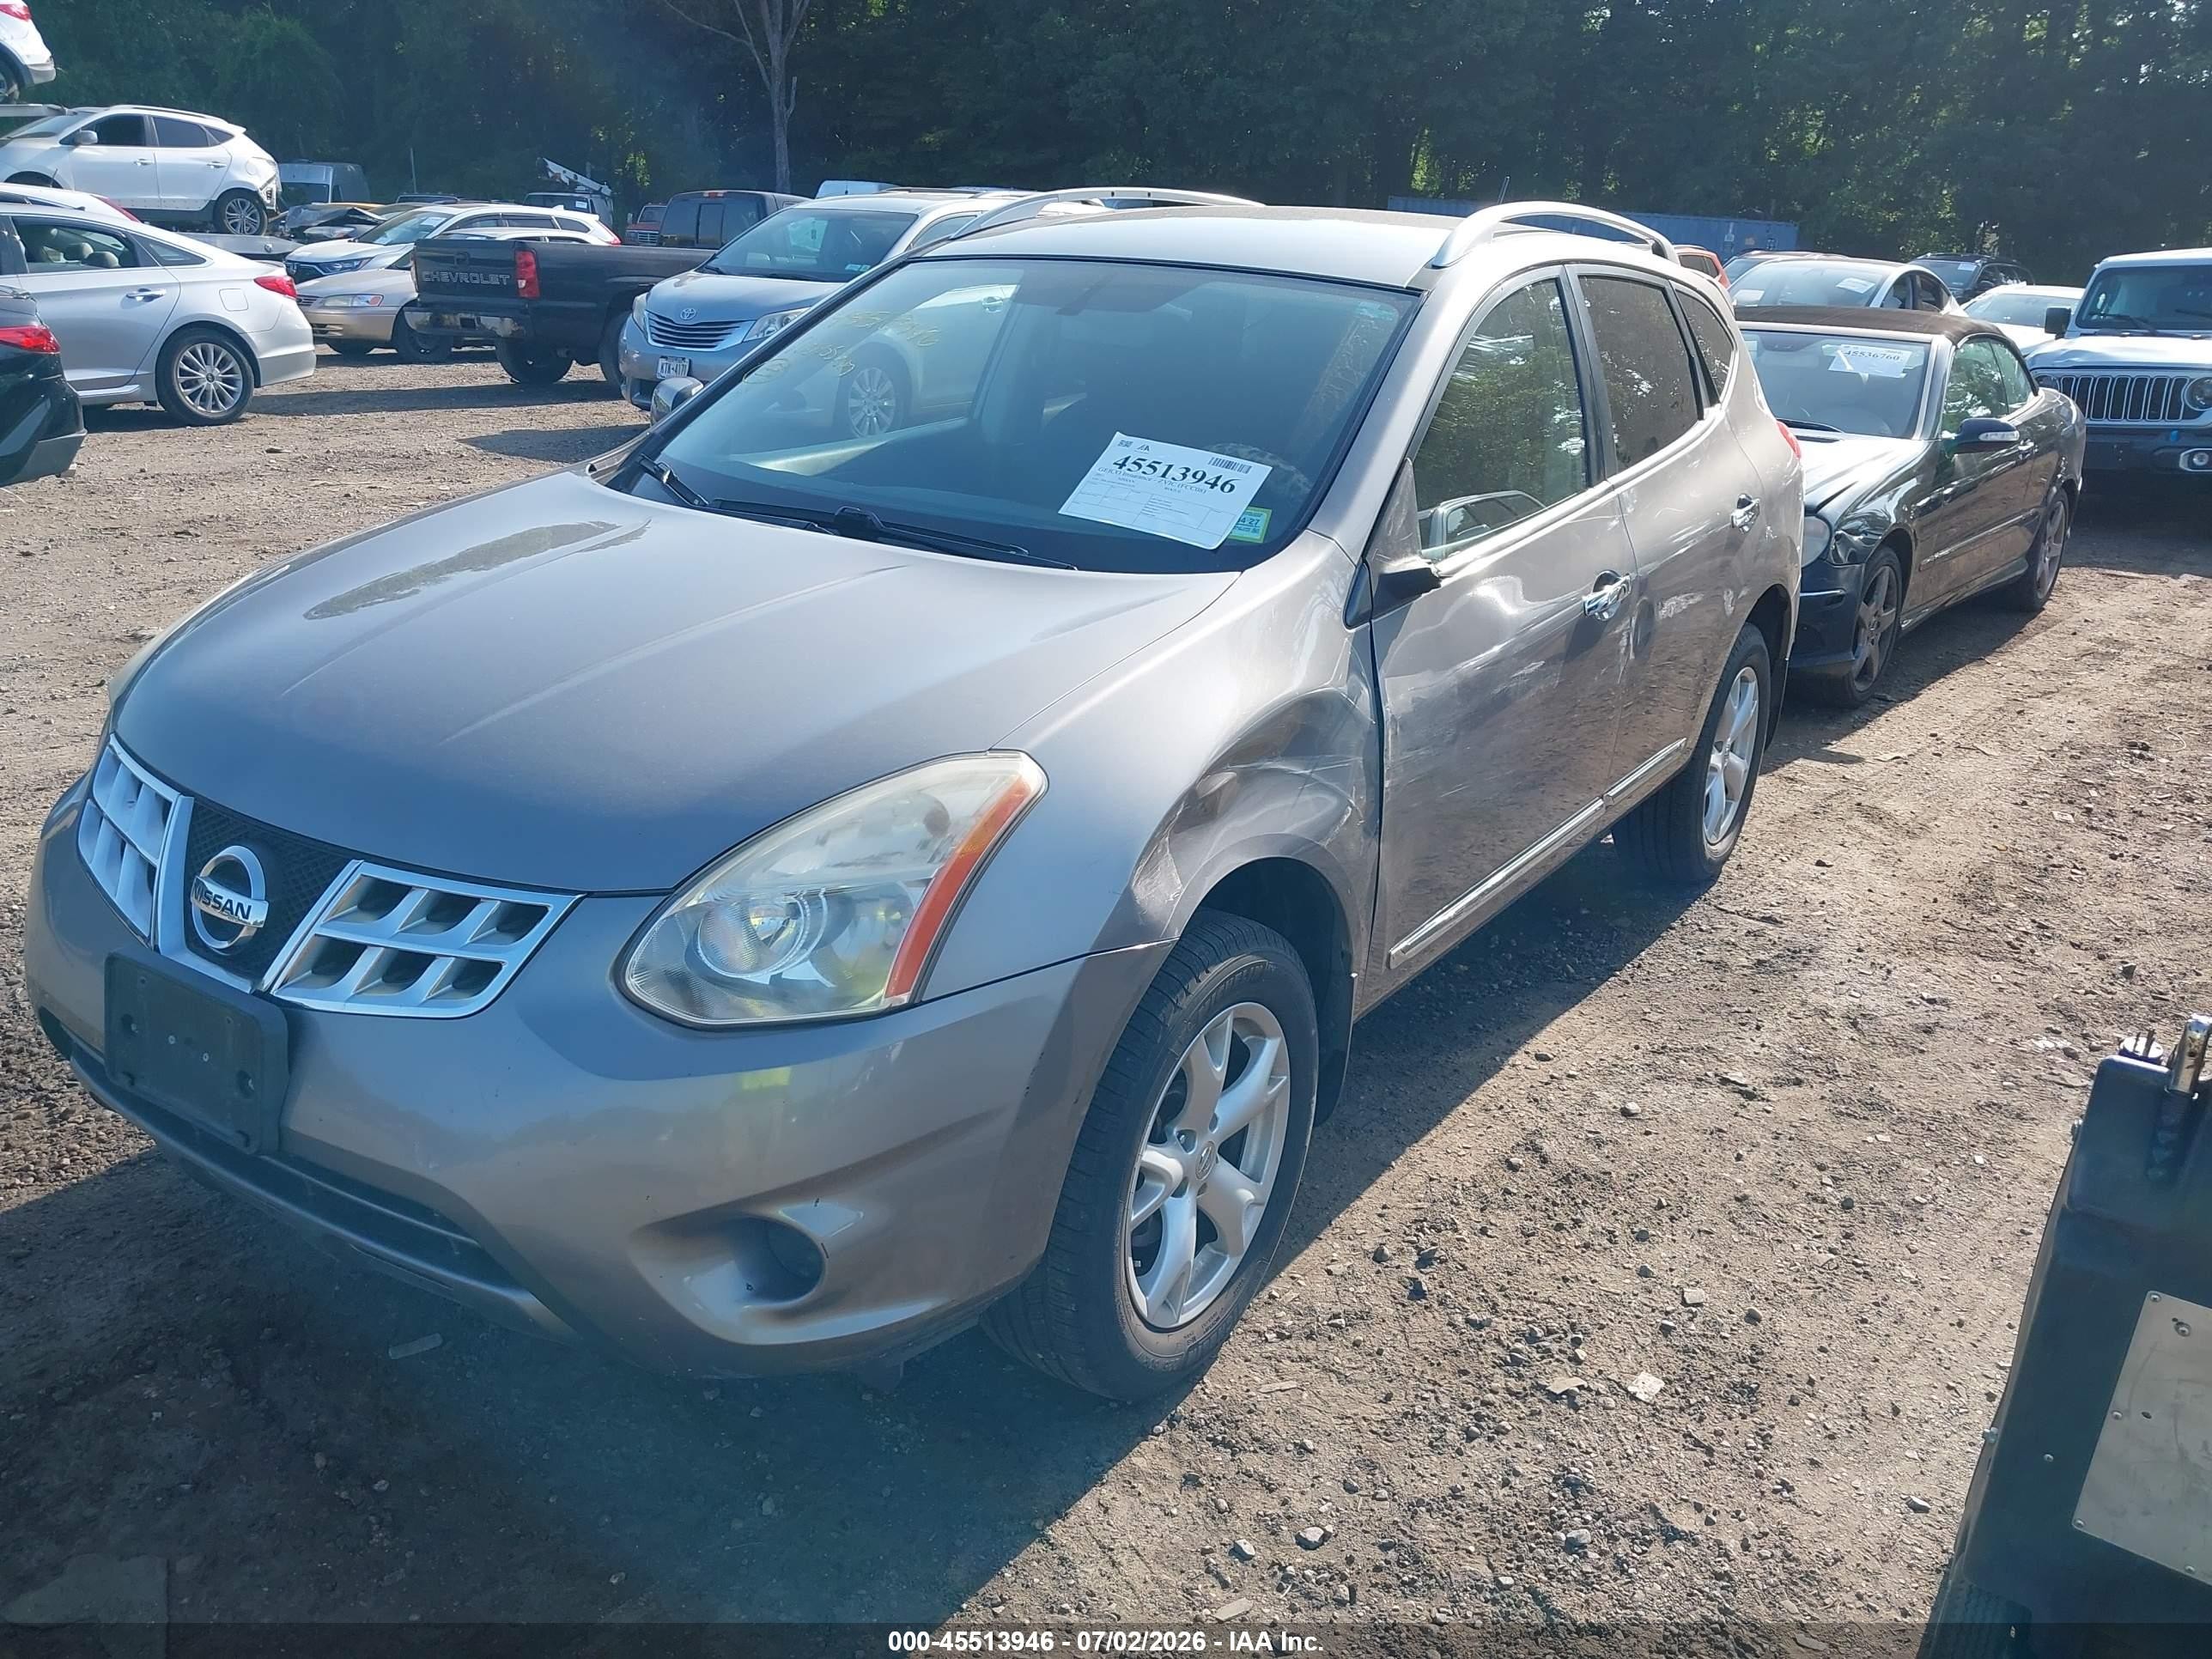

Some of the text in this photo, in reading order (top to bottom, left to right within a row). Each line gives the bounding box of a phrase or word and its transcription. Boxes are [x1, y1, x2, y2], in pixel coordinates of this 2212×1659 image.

[422, 270, 510, 285] CHEVROLET
[1112, 455, 1243, 494] 45513946
[193, 883, 252, 921] NISSAN
